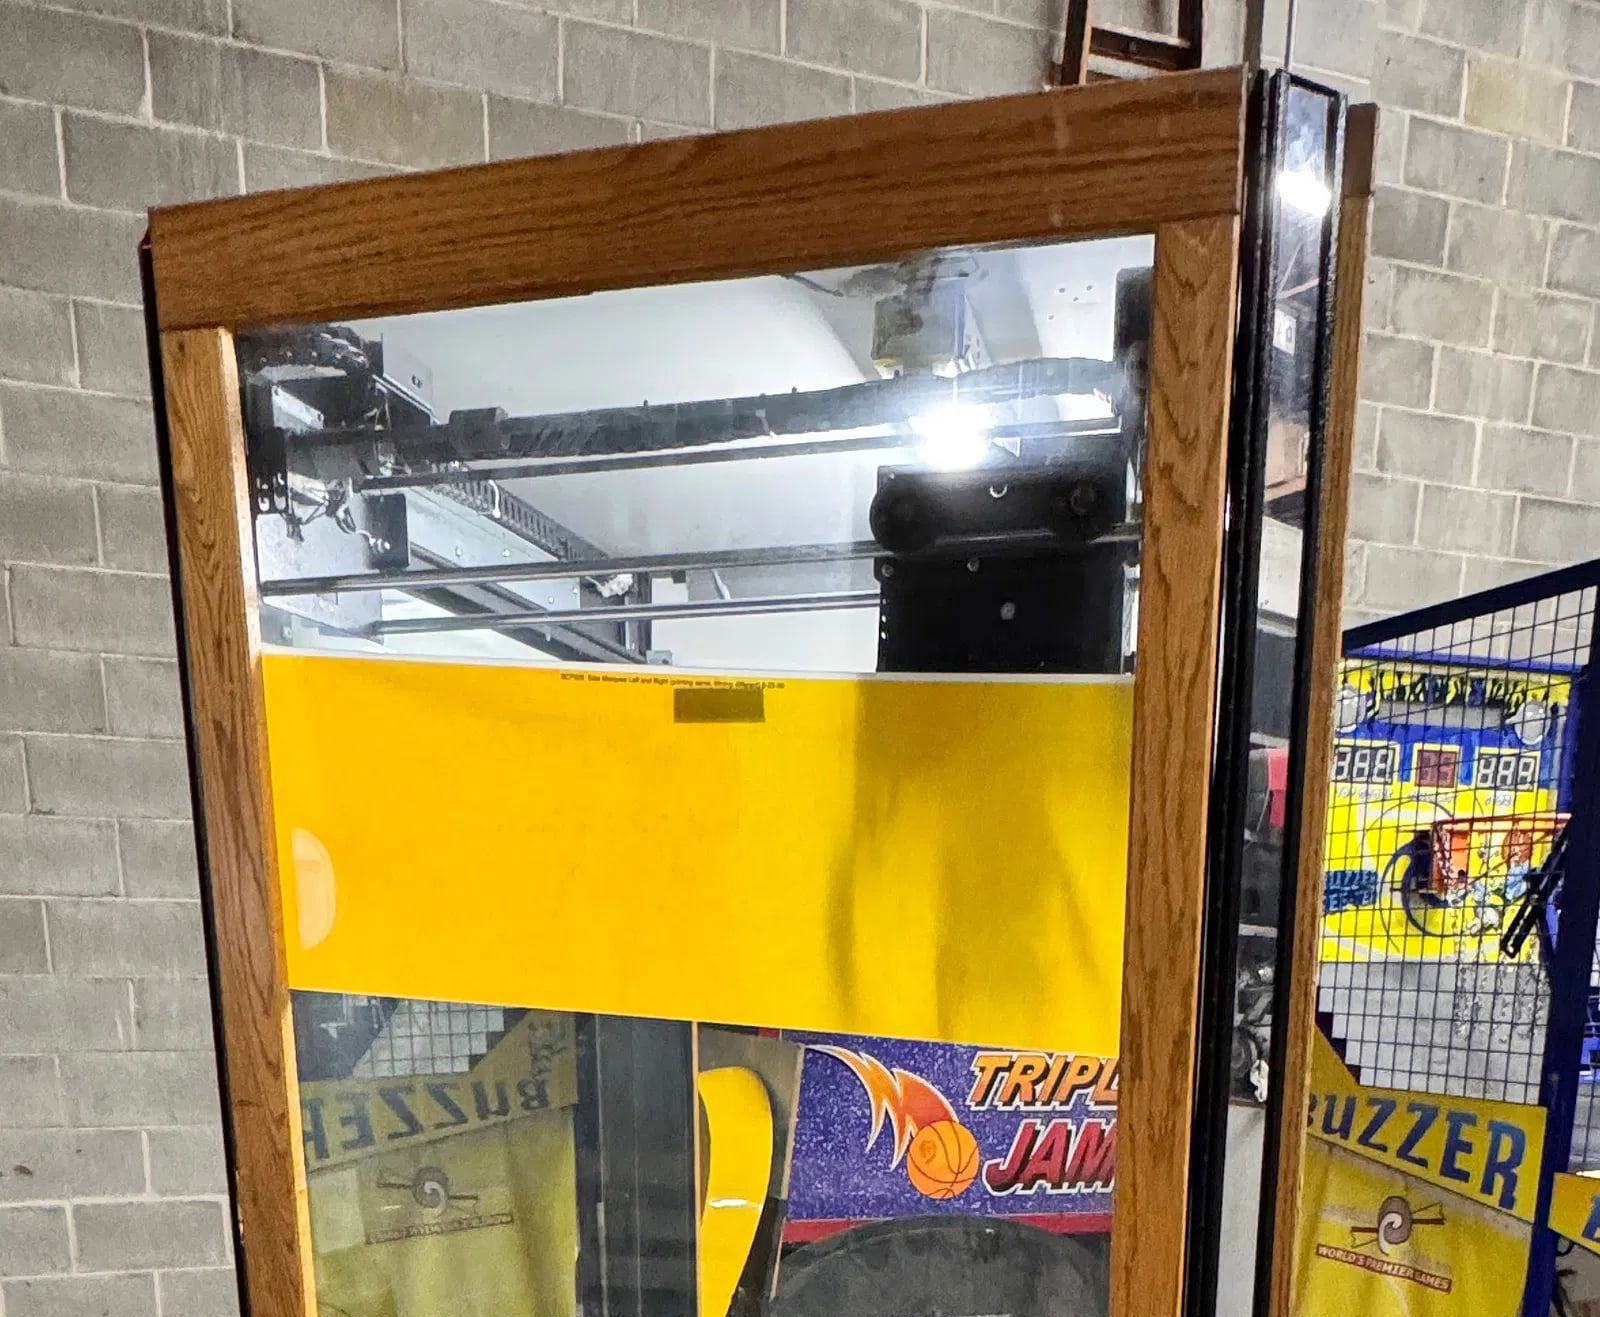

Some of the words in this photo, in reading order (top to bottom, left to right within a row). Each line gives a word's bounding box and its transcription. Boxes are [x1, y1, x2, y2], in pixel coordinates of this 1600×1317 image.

[966, 1051, 1118, 1112] TRIPL
[982, 1118, 1117, 1197] JAM
[1318, 1245, 1366, 1266] WORLD'S
[1365, 1258, 1414, 1281] PREMIER
[1414, 1269, 1451, 1289] GAMES
